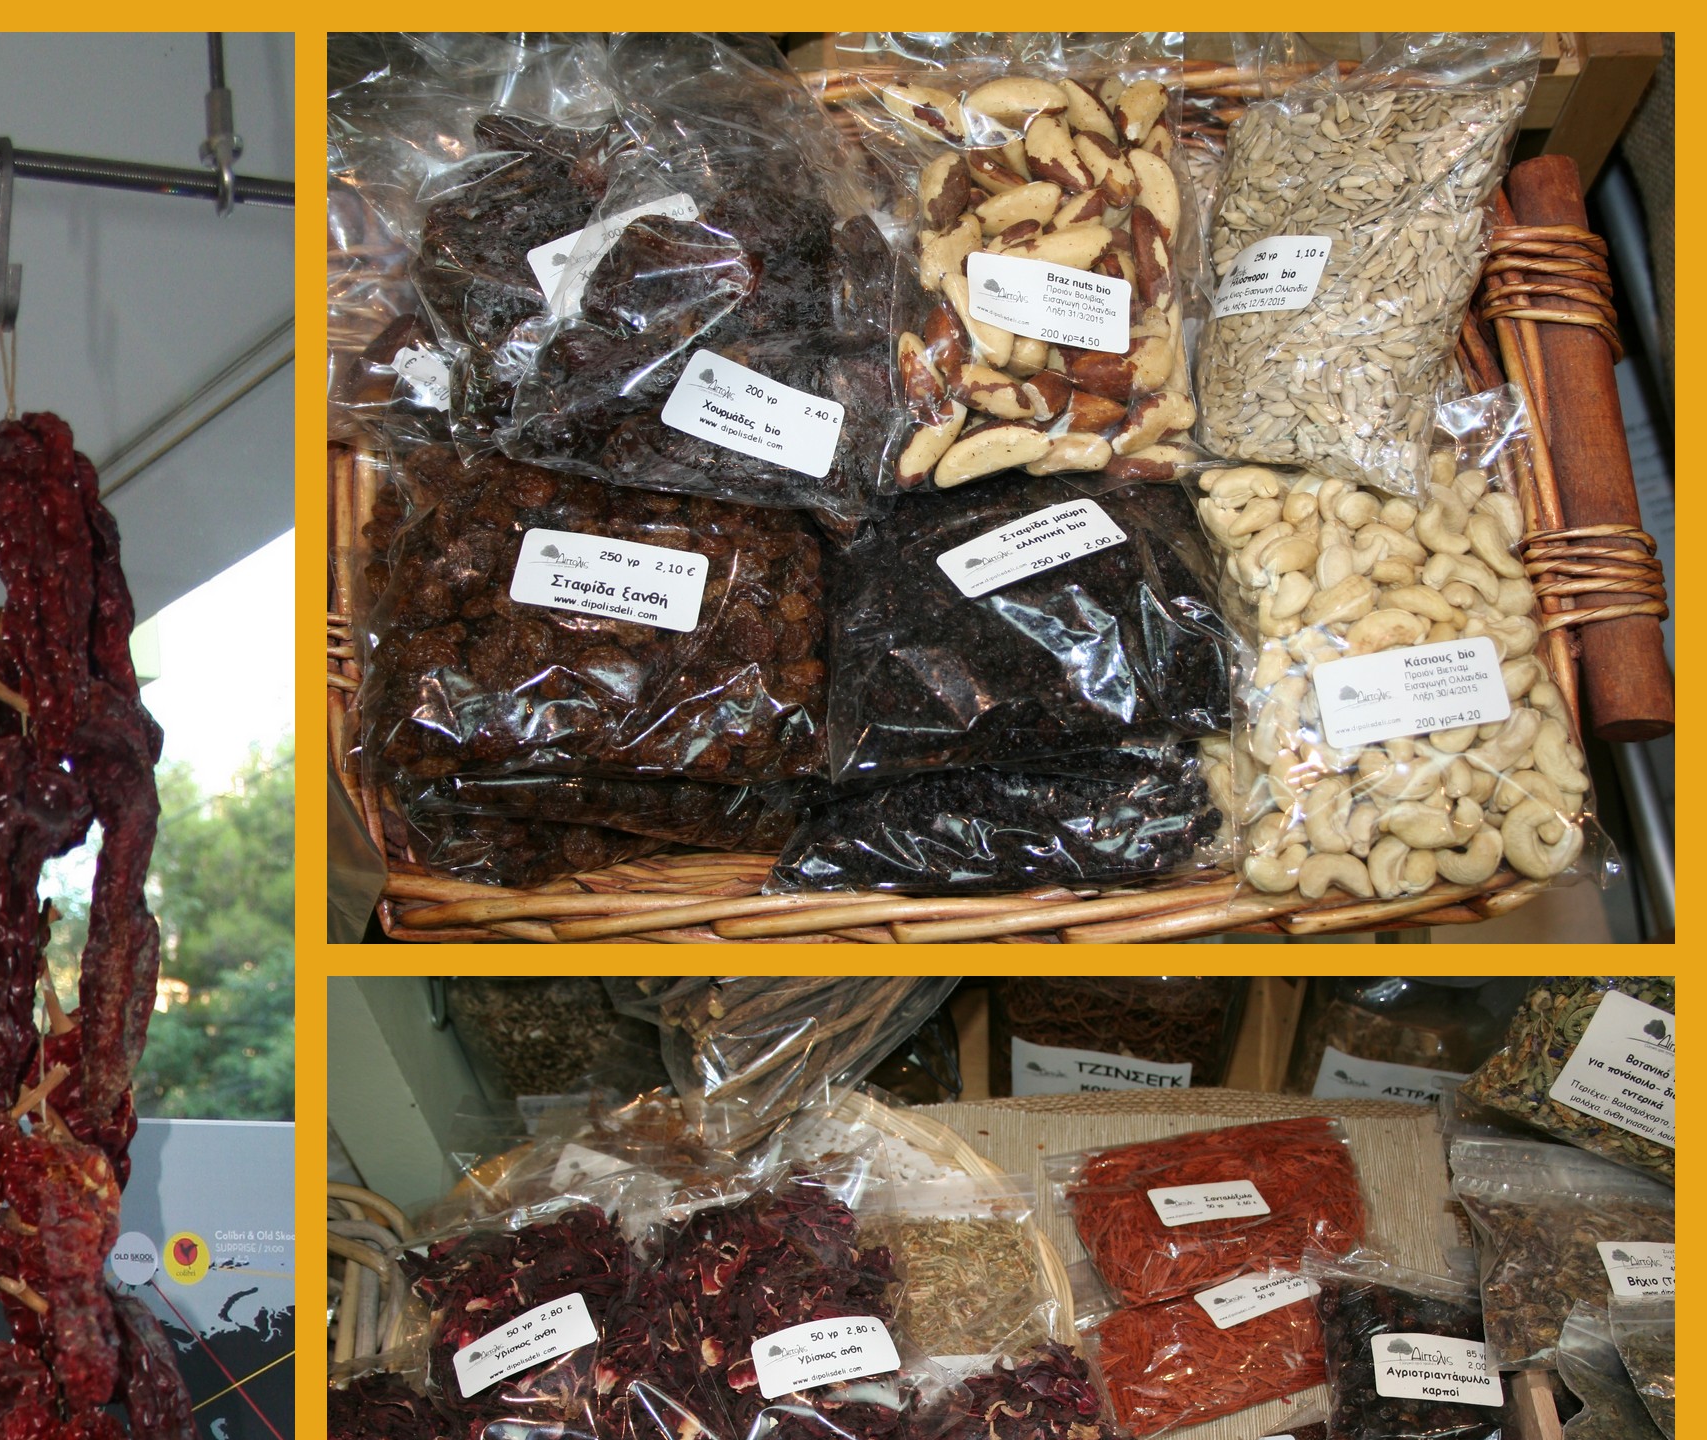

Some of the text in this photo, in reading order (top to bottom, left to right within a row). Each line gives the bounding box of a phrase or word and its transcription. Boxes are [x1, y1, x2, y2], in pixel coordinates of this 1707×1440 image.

[1047, 273, 1111, 295] Braz nuts bio
[1281, 269, 1296, 279] bio
[1249, 297, 1286, 307] 12/5/2015
[1068, 309, 1104, 324] 31/3/2015
[1041, 328, 1059, 339] 200
[745, 385, 764, 398] 200
[767, 395, 778, 405] γρ
[702, 399, 781, 436] Χουρμάδες bio
[999, 507, 1087, 542] Σταφίδα μαύρη
[1016, 520, 1086, 550] ελληνική bio
[600, 551, 695, 577] 250 γρ 2,10 €
[1031, 556, 1054, 570] 250
[551, 574, 668, 609] Σταφίδα ξανθή
[1404, 649, 1476, 667] Κάσιους bio
[1449, 671, 1488, 685] Ολλανδία
[1436, 683, 1478, 698] 30/4/2015
[1415, 717, 1436, 729] 200
[1588, 1057, 1605, 1069] για
[1625, 1054, 1670, 1078] Βοτανικό
[1570, 1079, 1609, 1101] Περιέχει:
[1622, 1088, 1664, 1110] εντερικά
[1570, 1095, 1601, 1113] μολόχα,
[1604, 1108, 1624, 1122] άνθη
[507, 1327, 519, 1338] 50
[495, 1327, 557, 1361] Υβίσκος άνθη
[1387, 1366, 1491, 1386] Αγριοτριαντάφυλλο
[1422, 1386, 1459, 1397] καρποί
